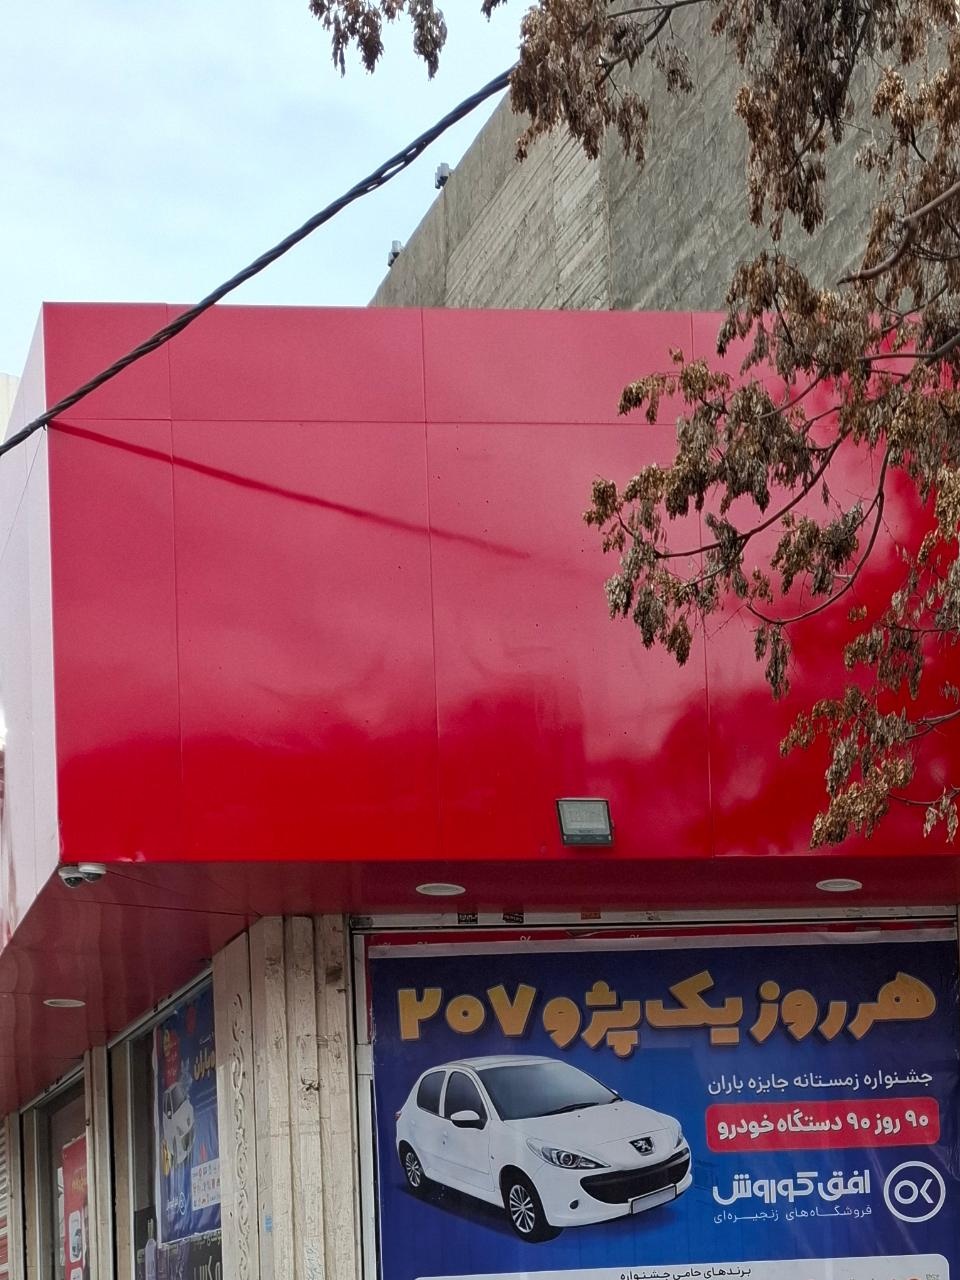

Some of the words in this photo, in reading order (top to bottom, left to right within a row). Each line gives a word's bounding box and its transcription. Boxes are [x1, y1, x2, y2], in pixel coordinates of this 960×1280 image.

[397, 983, 537, 1042] ۲۰۷
[645, 970, 744, 1046] یک
[749, 980, 848, 1044] روز
[848, 971, 937, 1041] هر
[542, 980, 642, 1057] پژو
[708, 1075, 744, 1095] باران
[748, 1074, 789, 1094] جایزه
[793, 1072, 861, 1091] زمستانه
[864, 1069, 933, 1090] جشنواره
[717, 1114, 774, 1140] خودرو
[777, 1109, 843, 1132] دستگاه
[846, 1112, 871, 1130] ۹۰
[875, 1113, 901, 1135] روز
[905, 1110, 929, 1127] ۹۰
[712, 1171, 818, 1206] کوروش
[817, 1169, 871, 1201] افق
[673, 1268, 701, 1280] حامی
[704, 1266, 751, 1280] برندهای
